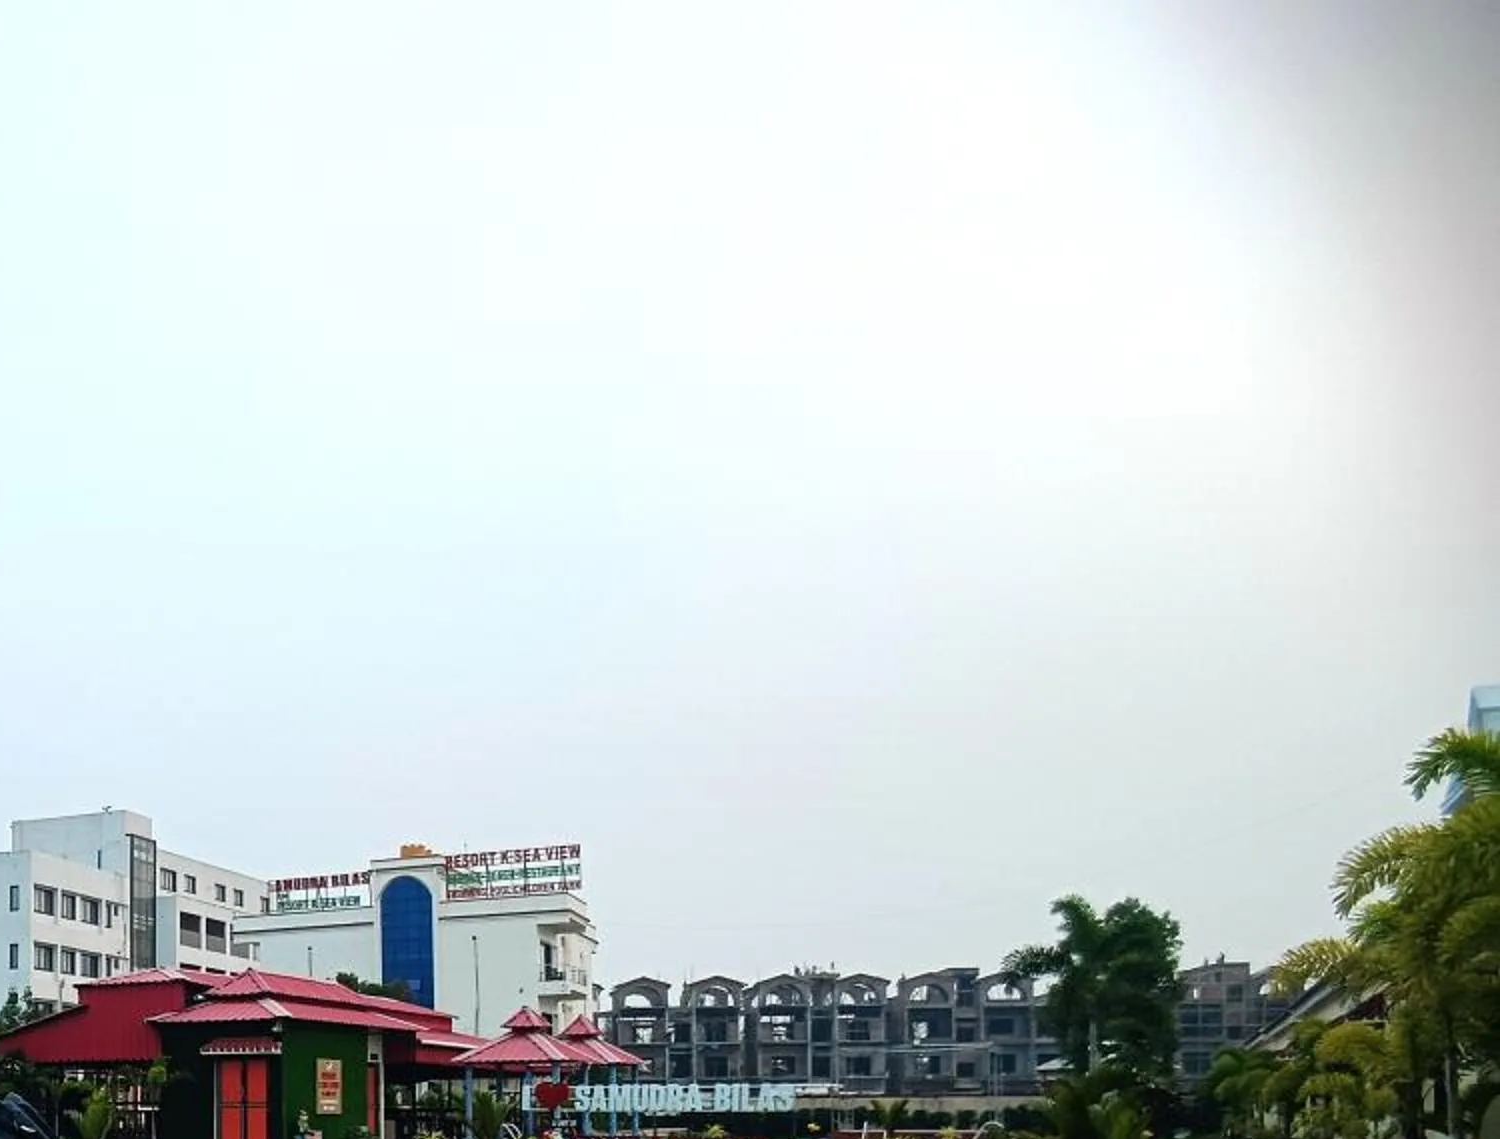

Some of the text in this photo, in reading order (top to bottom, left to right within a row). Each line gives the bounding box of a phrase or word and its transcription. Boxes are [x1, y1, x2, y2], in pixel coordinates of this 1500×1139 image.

[445, 852, 495, 869] RESORT
[514, 848, 541, 863] SEA
[545, 844, 581, 860] VIEW
[574, 1083, 701, 1113] SAMUDRA
[714, 1083, 796, 1112] BILAS
